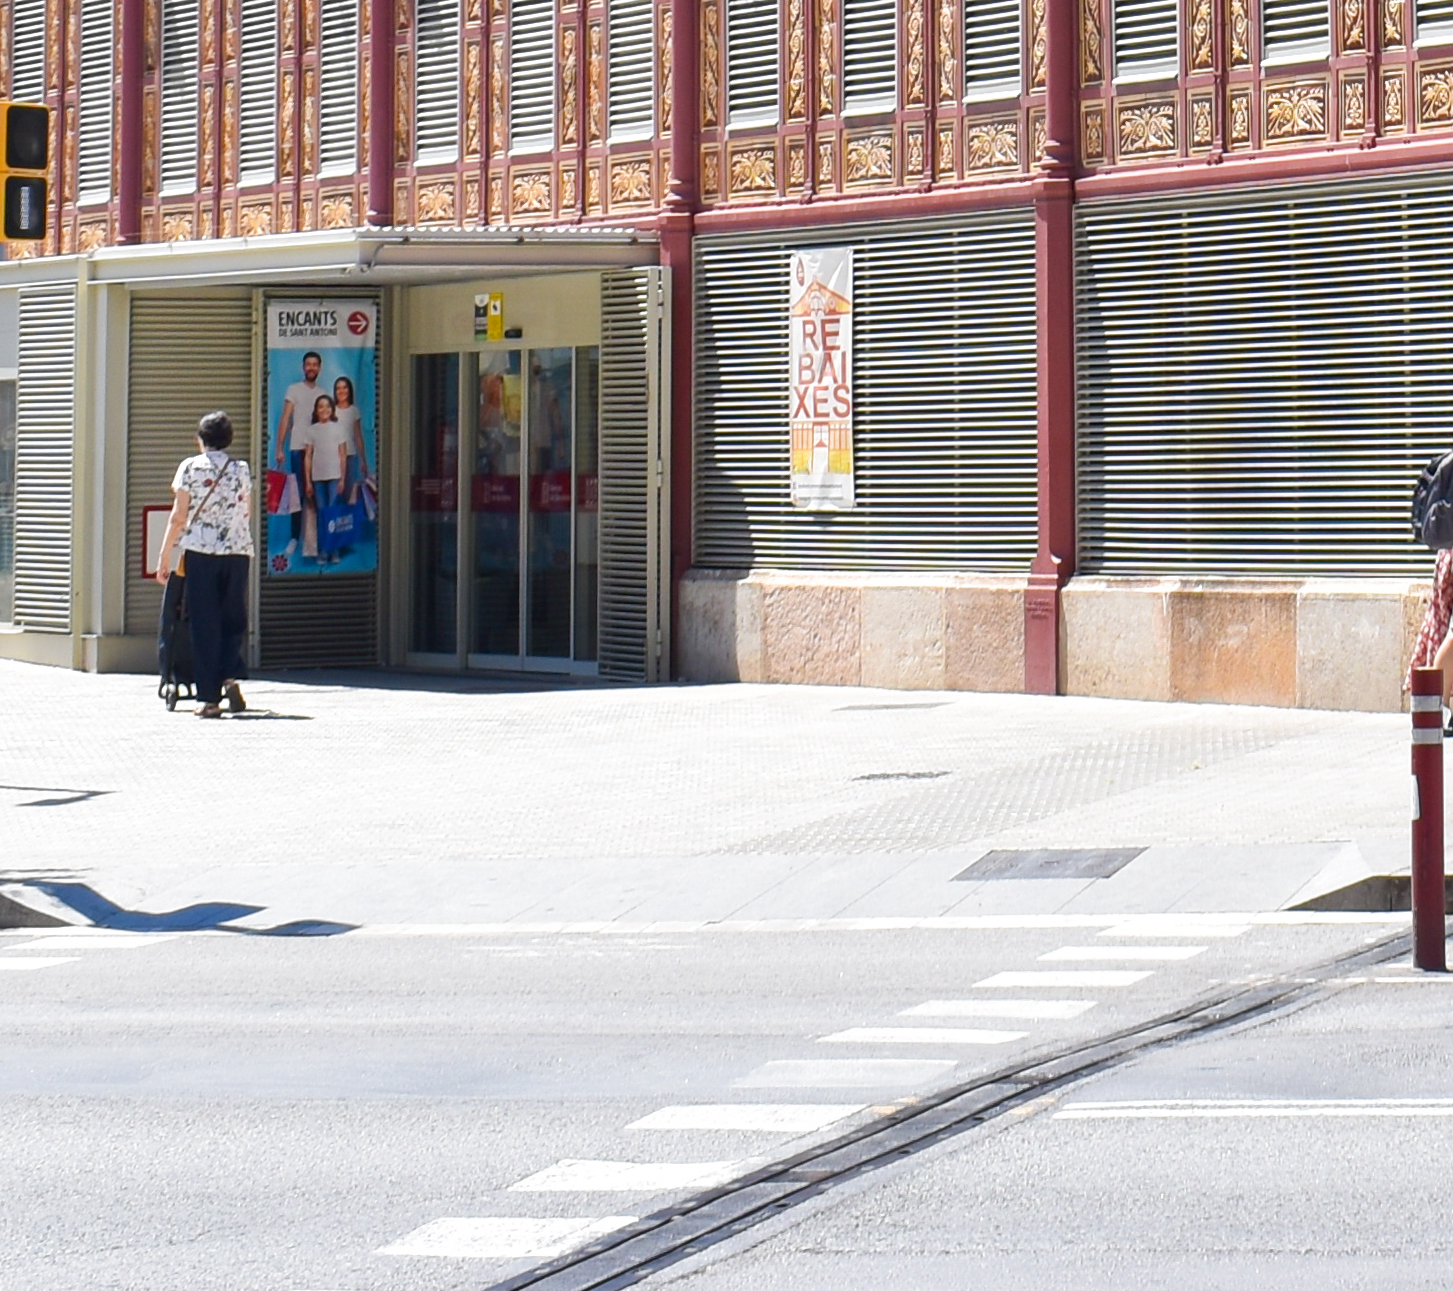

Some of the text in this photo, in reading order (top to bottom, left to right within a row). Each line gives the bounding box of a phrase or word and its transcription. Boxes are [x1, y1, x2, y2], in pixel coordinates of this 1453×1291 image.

[278, 310, 338, 327] ENCANTS
[278, 327, 338, 337] DE SANT ANTONI
[801, 318, 842, 351] RE
[798, 351, 847, 386] BAI
[793, 384, 852, 419] XES
